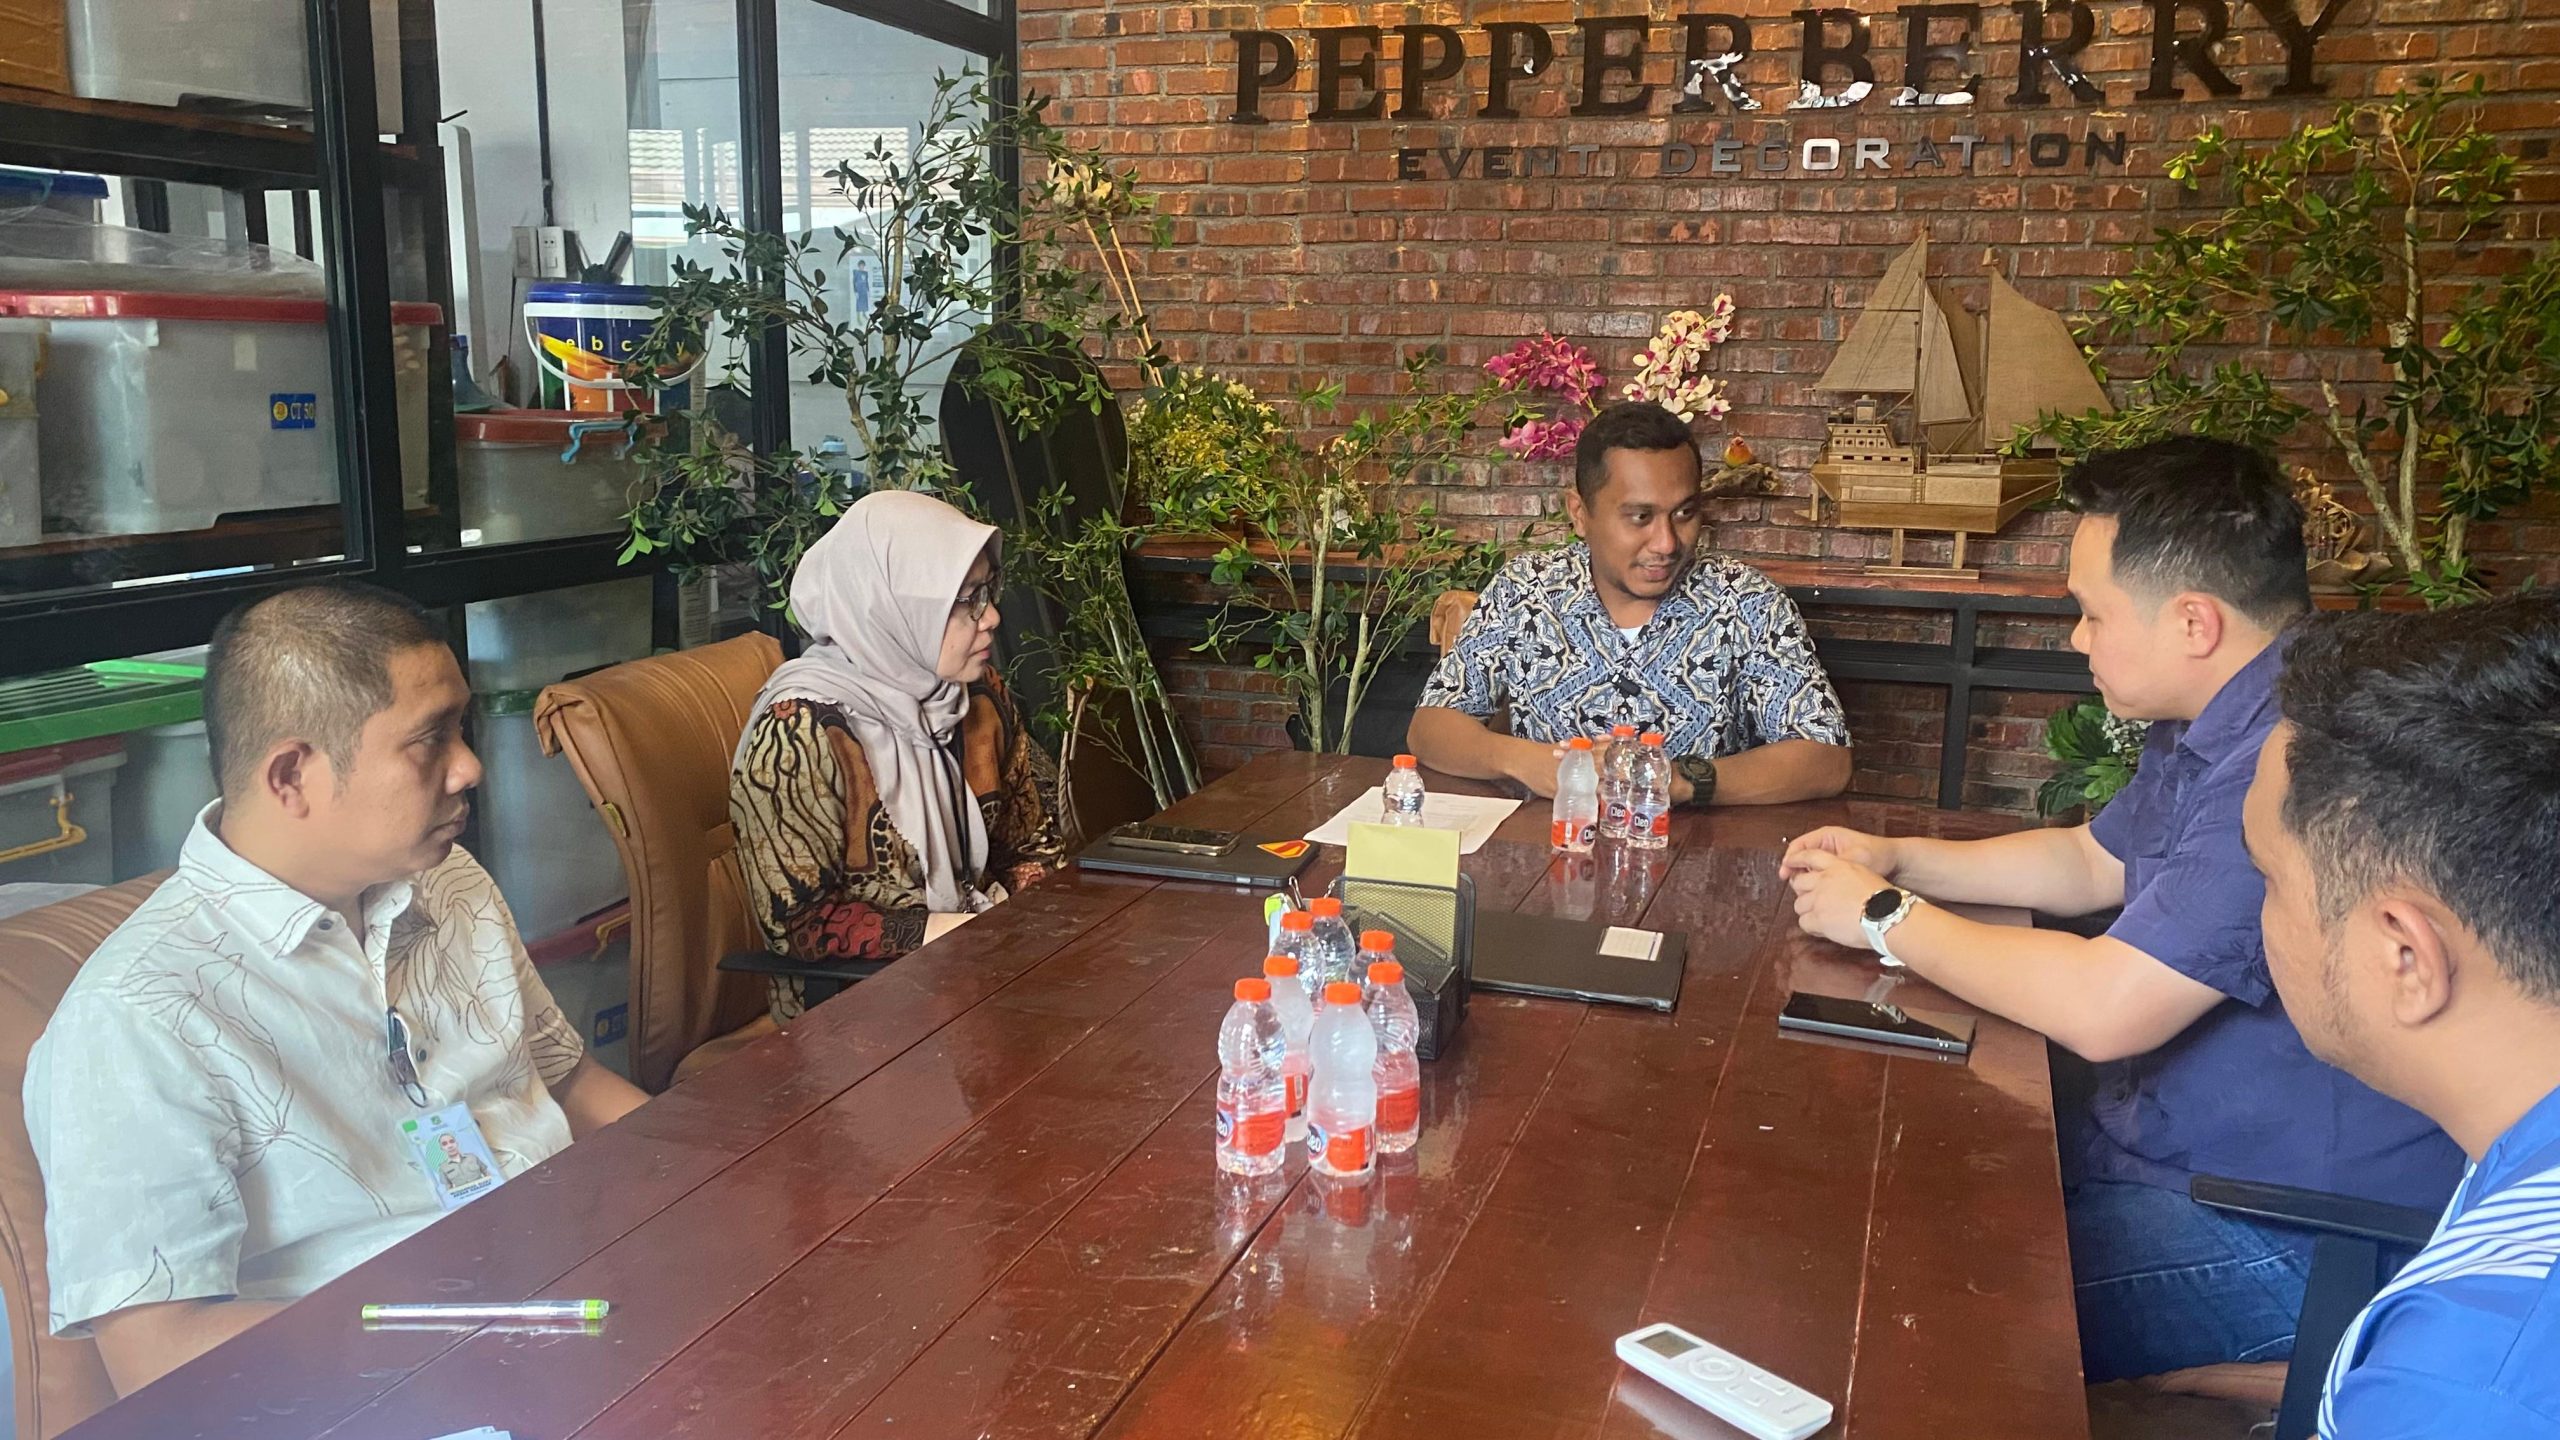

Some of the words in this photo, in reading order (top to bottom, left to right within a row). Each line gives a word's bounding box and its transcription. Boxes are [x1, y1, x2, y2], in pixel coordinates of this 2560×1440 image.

[1227, 0, 2347, 123] PEPPERBERRY
[1398, 144, 1600, 180] EVENT
[1660, 133, 2126, 177] DECORATION
